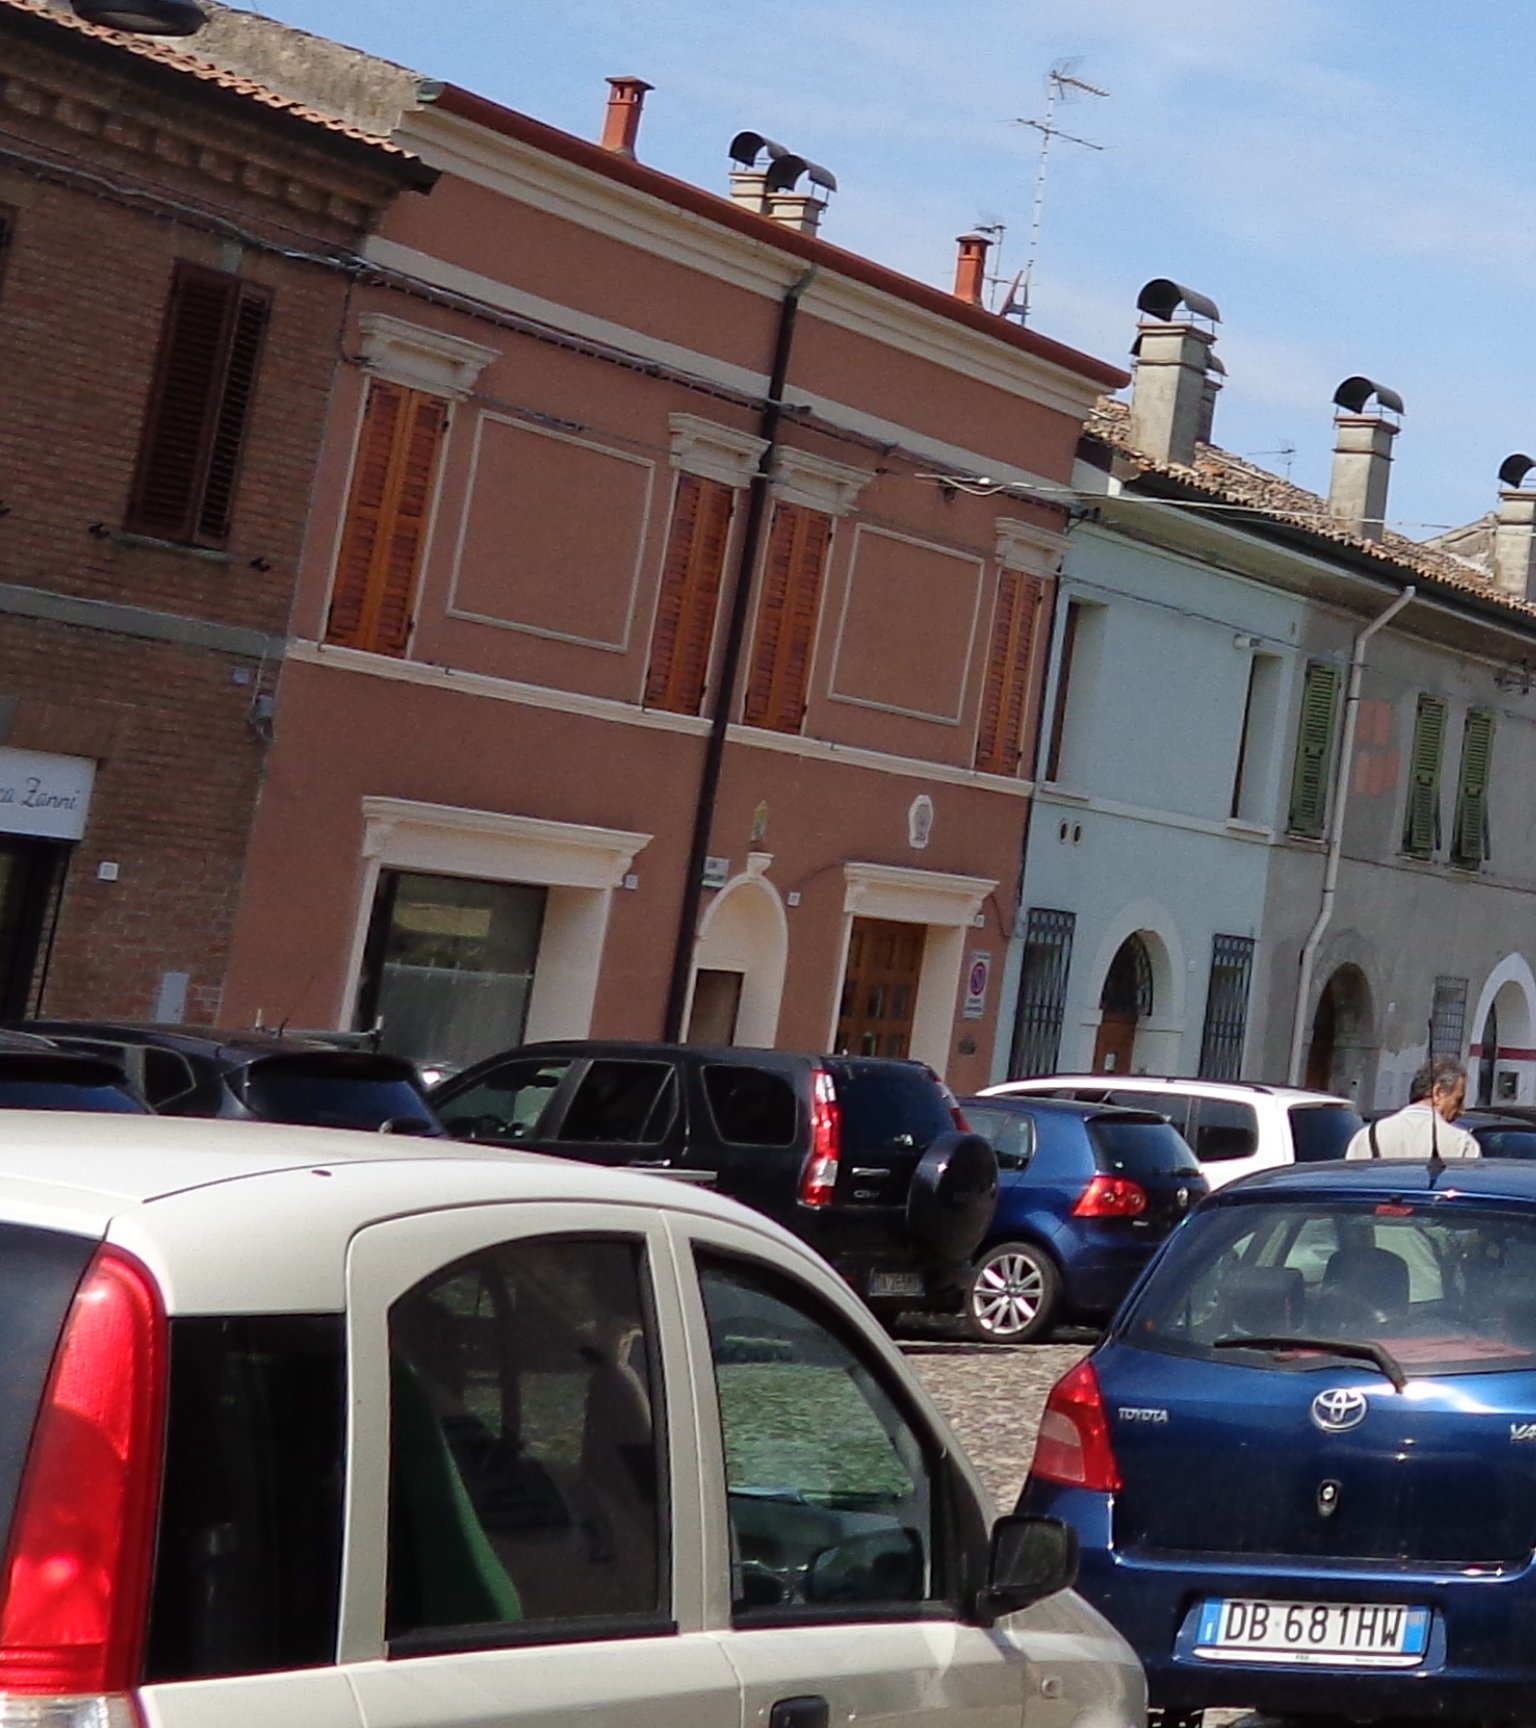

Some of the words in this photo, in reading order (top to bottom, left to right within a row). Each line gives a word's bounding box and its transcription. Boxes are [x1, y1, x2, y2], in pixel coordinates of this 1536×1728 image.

[1118, 1407, 1168, 1423] TOYOTA
[1224, 1600, 1270, 1641] DB
[1284, 1604, 1402, 1647] 681HW
